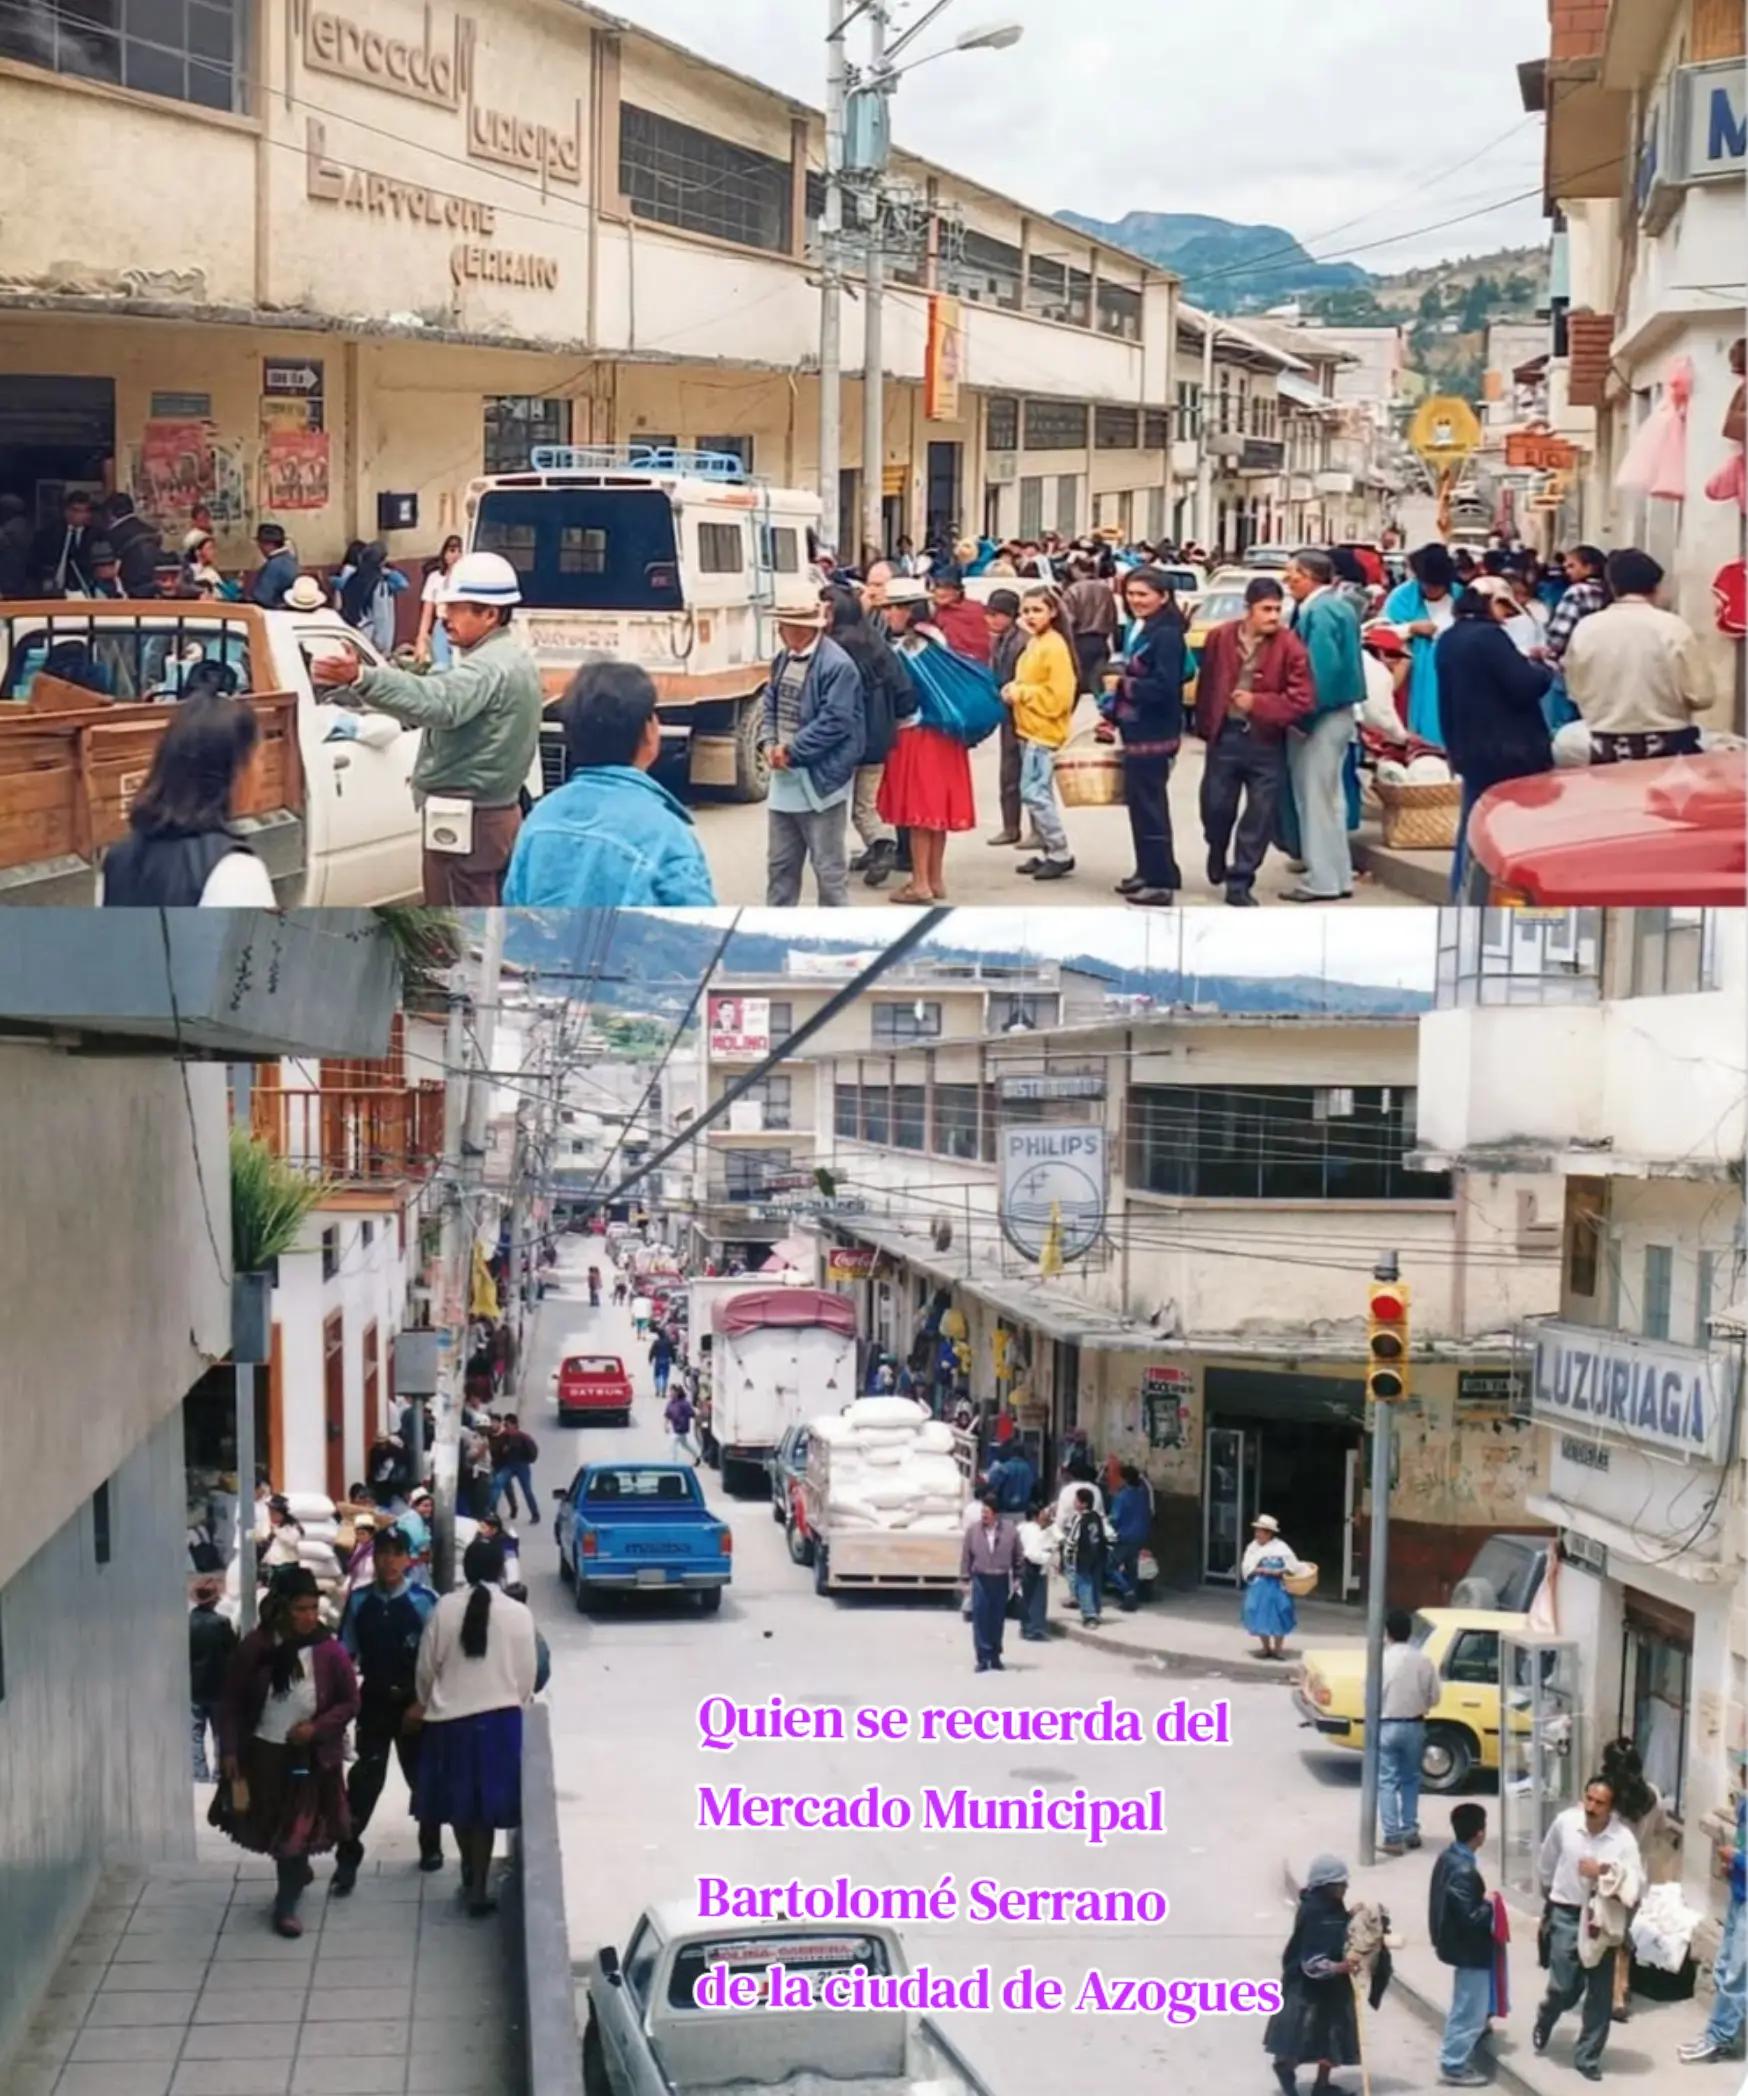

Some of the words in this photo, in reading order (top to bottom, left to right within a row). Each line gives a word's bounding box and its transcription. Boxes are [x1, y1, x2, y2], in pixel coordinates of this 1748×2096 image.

[1009, 1135, 1098, 1157] PHILIPS
[569, 1387, 625, 1396] DATSUN
[1534, 1341, 1705, 1444] LUZURIAGA
